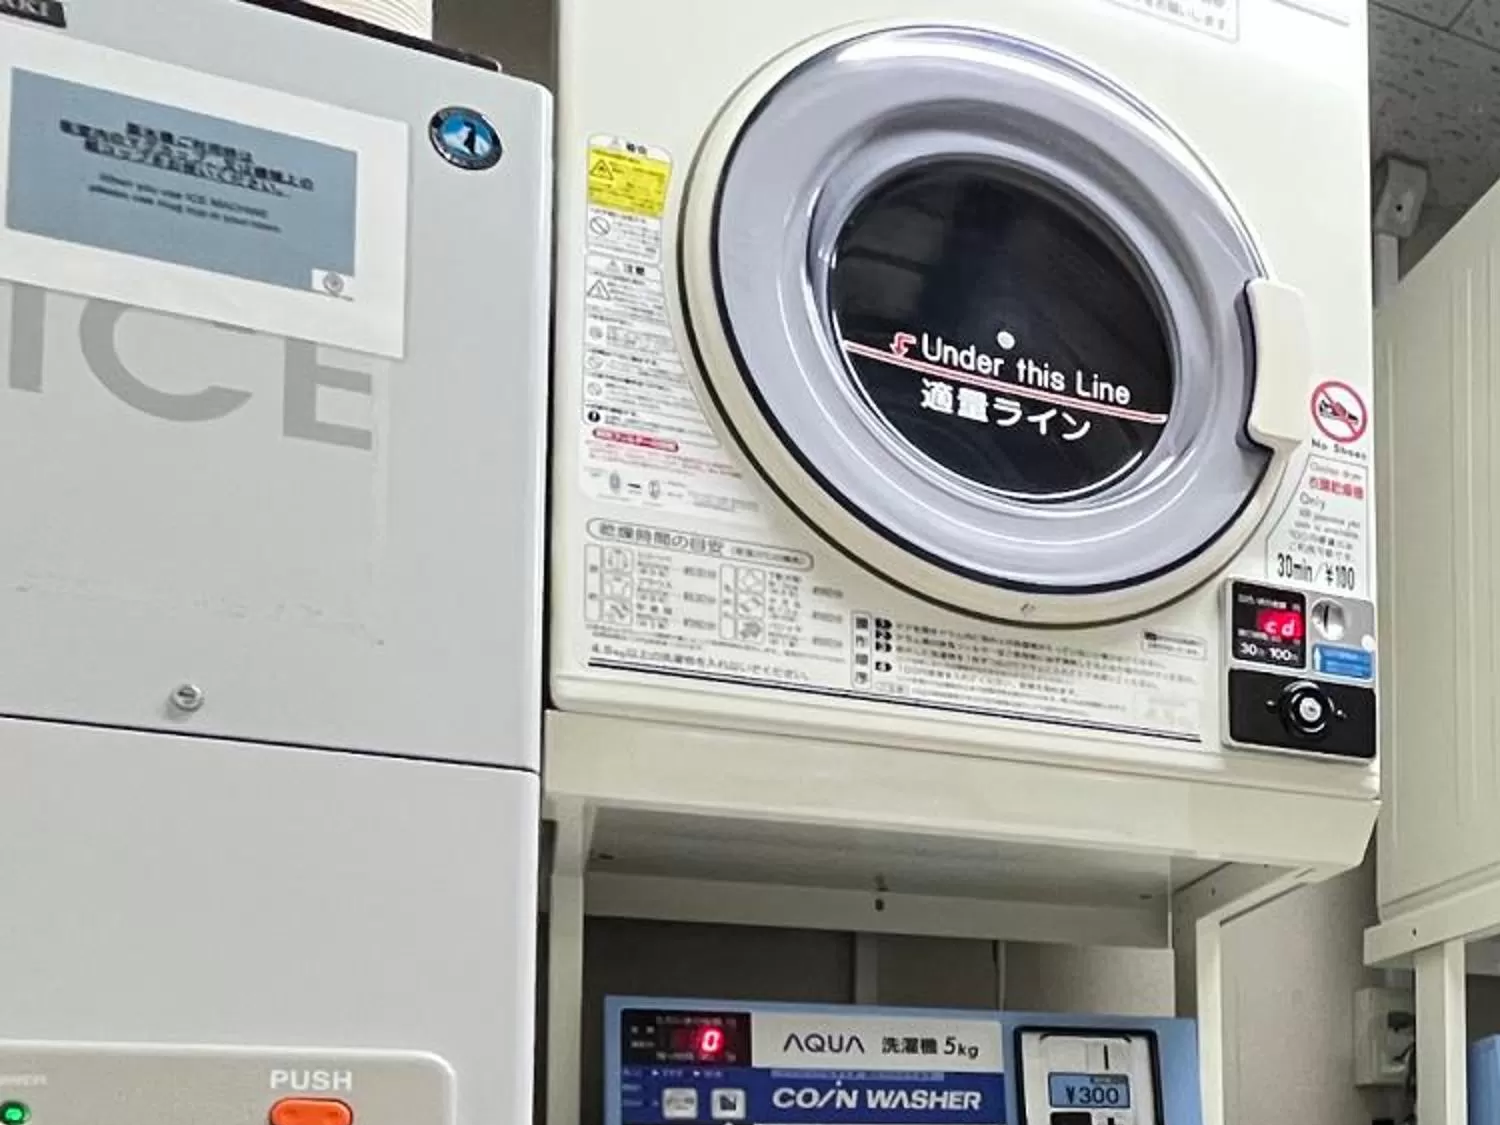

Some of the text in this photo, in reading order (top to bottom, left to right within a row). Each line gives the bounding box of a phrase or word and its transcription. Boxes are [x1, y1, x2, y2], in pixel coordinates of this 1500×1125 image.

[920, 331, 1131, 406] Under this Line
[920, 377, 1092, 442] 適量ライン
[783, 1031, 980, 1060] AQUA 洗濯機 5kg
[269, 1069, 354, 1093] PUSH
[866, 1089, 983, 1111] WASHER
[1064, 1084, 1121, 1106] ¥300
